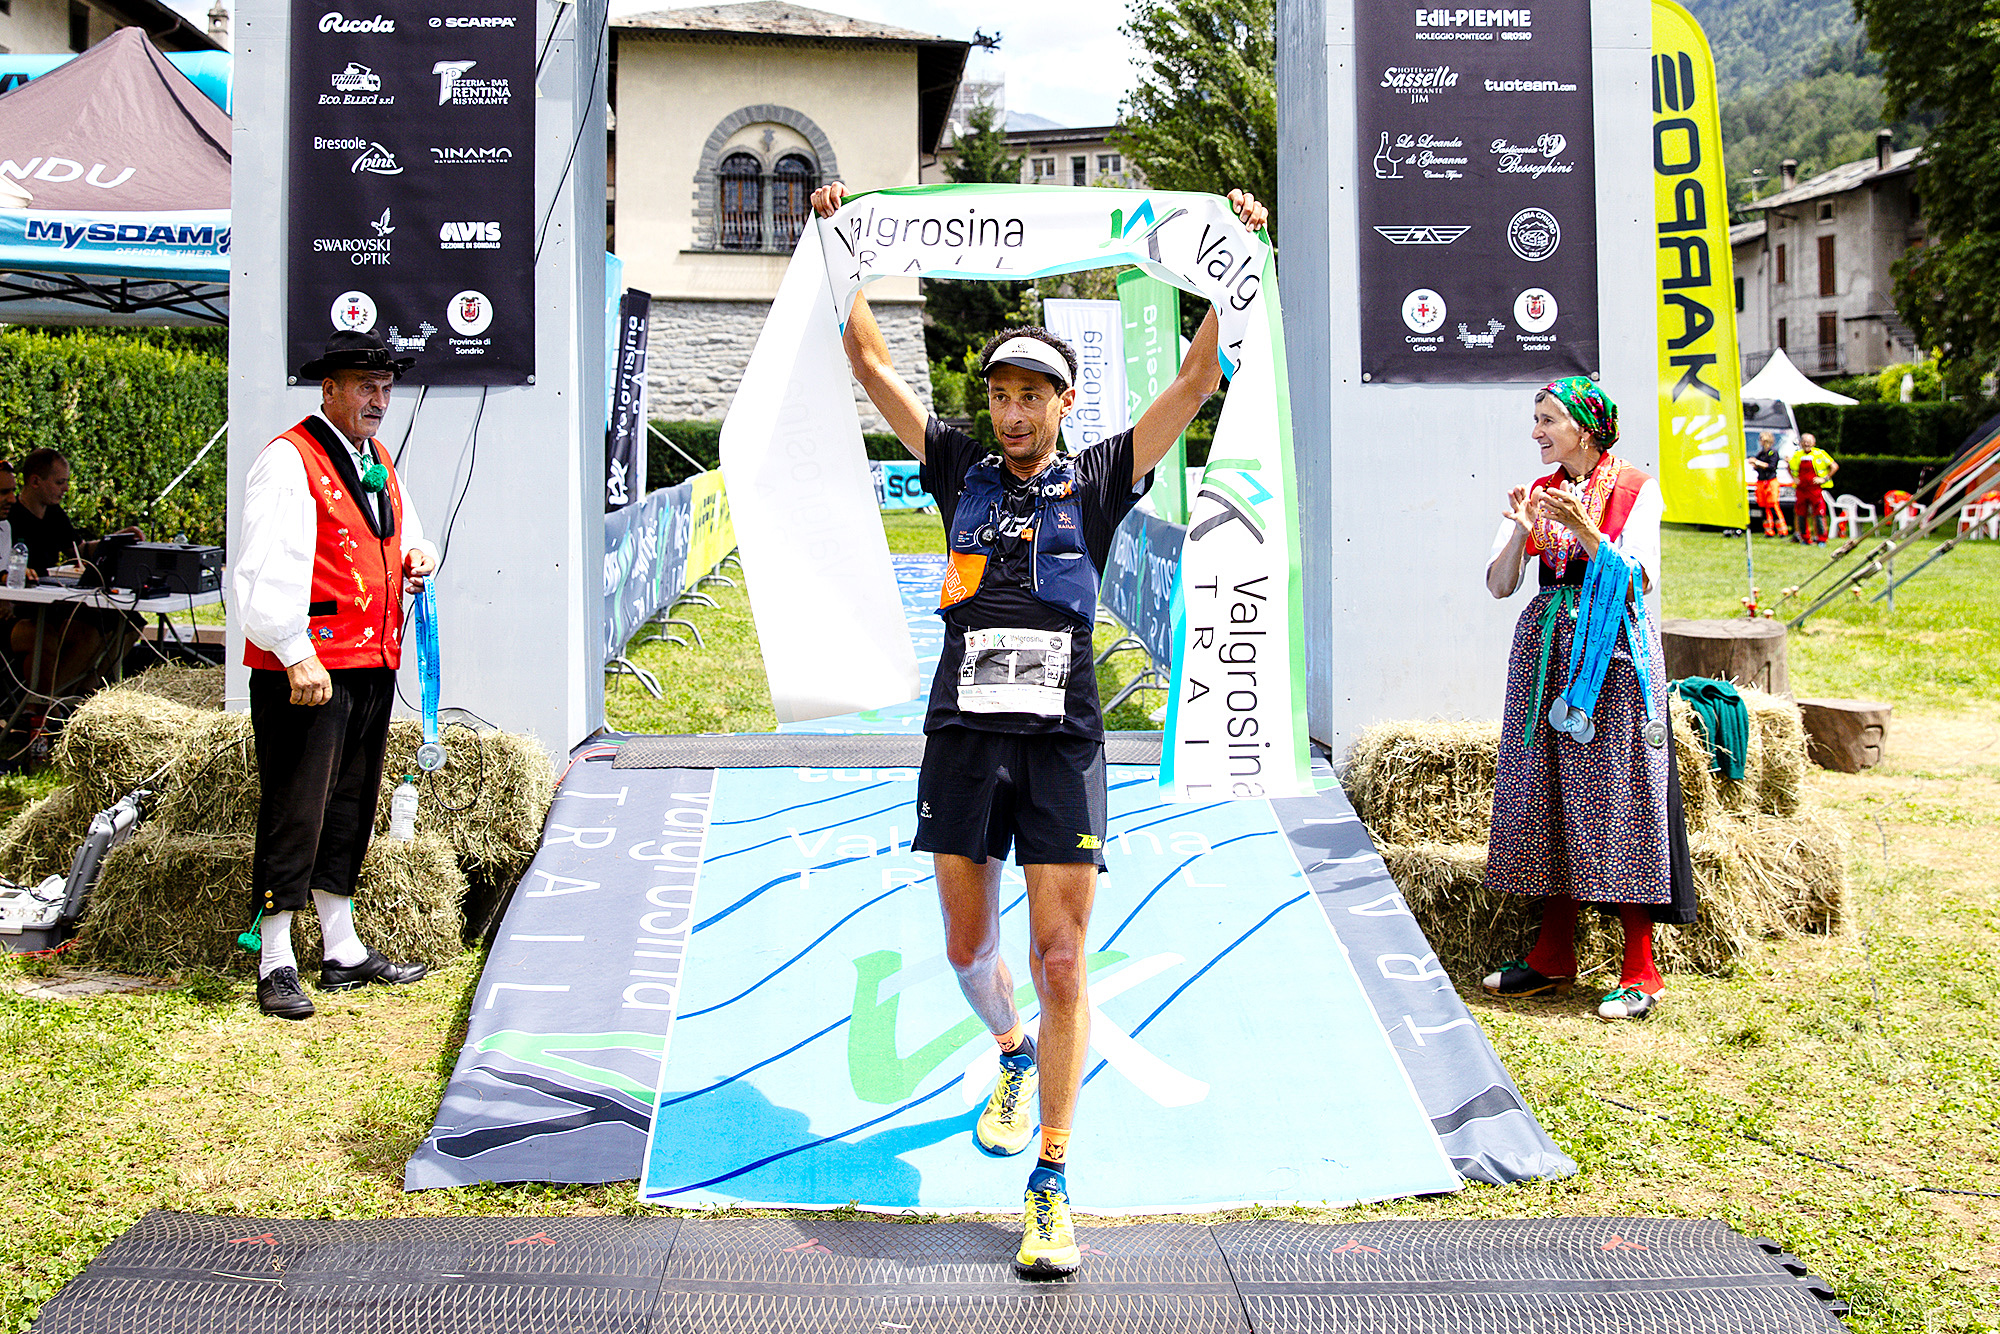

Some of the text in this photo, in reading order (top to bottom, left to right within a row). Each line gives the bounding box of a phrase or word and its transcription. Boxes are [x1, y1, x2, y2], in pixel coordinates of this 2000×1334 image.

[318, 12, 395, 33] Ricola
[445, 17, 515, 28] SCARPA
[1415, 9, 1532, 27] Edil-PIEMME
[1415, 32, 1533, 40] NOLEGGIO PONTEGGI GROSIO
[490, 79, 509, 87] BAR
[1380, 65, 1459, 88] Sassella
[1484, 78, 1577, 92] tuoteam.com
[452, 97, 509, 105] RISTORANTE
[1411, 94, 1429, 105] JIM
[314, 136, 367, 150] Bresaole
[1395, 133, 1463, 149] La Locanda
[430, 147, 513, 159] DINAMO
[1405, 150, 1468, 168] di Giovanna
[1497, 153, 1575, 179] Besseghini
[1511, 211, 1536, 235] LATTERIA
[27, 219, 214, 250] MySDAM
[440, 221, 502, 242] AVIS
[313, 238, 391, 252] SWAROVSKI
[440, 242, 465, 250] SEZIONE
[465, 242, 473, 250] DI
[115, 247, 170, 258] OFFICIAL
[350, 252, 391, 266] OPTIK
[399, 337, 426, 347] BIM
[449, 338, 491, 346] Provincia di
[1405, 335, 1444, 343] Comune di
[1467, 335, 1494, 344] BIM
[1516, 334, 1557, 343] Provincia di
[455, 347, 485, 355] Sondrio
[1412, 343, 1437, 352] Grosio
[1522, 343, 1551, 351] Sondrio
[1004, 650, 1019, 684] 1
[1184, 575, 1218, 800] TRAIL
[1218, 575, 1270, 799] Valgrosina
[485, 786, 630, 1010] TRAIL
